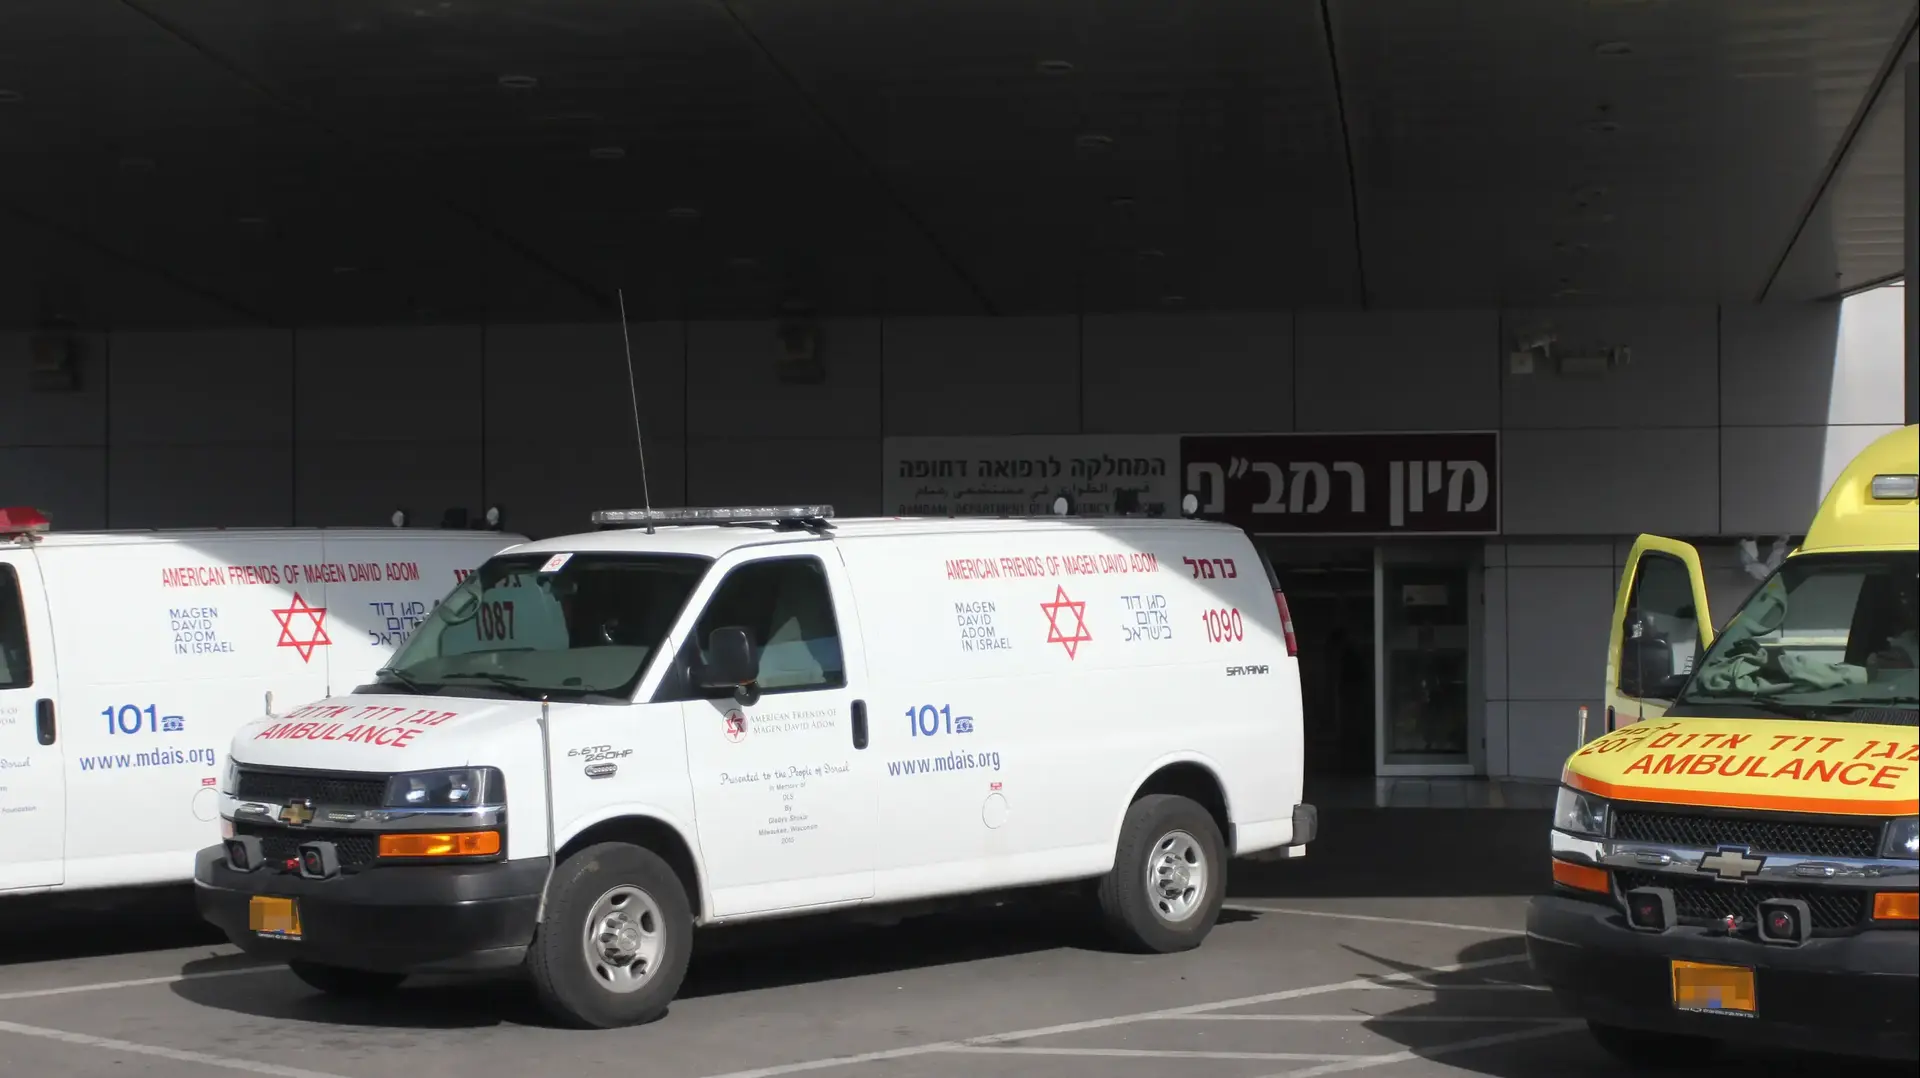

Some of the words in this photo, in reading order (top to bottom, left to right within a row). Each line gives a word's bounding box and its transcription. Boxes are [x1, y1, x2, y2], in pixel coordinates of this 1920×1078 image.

[900, 459, 967, 478] דחופה
[978, 455, 1061, 479] לרפואה
[1070, 453, 1165, 481] המחלקה
[1388, 460, 1489, 526] מיון
[162, 566, 226, 588] AMERICAN
[228, 564, 280, 585] FRIENDS
[284, 564, 300, 584] OF
[303, 563, 347, 584] MAGEN
[351, 562, 382, 582] DAVID
[386, 561, 420, 581] ADOM
[946, 558, 1000, 580] AMERICAN
[1000, 556, 1046, 578] FRIENDS
[1046, 555, 1060, 576] OF
[1062, 554, 1100, 575] MAGEN
[1100, 553, 1128, 573] DAVID
[1132, 552, 1159, 572] ADOM
[1183, 556, 1237, 579] כרמל
[369, 603, 394, 616] דוד
[955, 601, 996, 614] MAGEN
[1121, 595, 1141, 610] דוד
[169, 607, 218, 620] MAGEN
[958, 614, 992, 627] DAVID
[1136, 610, 1168, 625] אדום
[171, 619, 213, 632] DAVID
[962, 626, 996, 639] ADOM
[1121, 626, 1172, 641] בישראל
[1203, 607, 1243, 643] 1090
[174, 631, 216, 643] ADOM
[962, 639, 974, 652] IN
[976, 638, 1012, 651] ISRAEL
[175, 642, 188, 655] IN
[192, 641, 235, 654] ISRAEL
[1226, 664, 1270, 677] SAVANA
[101, 703, 157, 735] 101
[750, 711, 790, 723] AMERICAN
[792, 709, 825, 720] FRIENDS
[905, 703, 952, 737] 101
[254, 722, 425, 748] AMBULANCE
[753, 723, 782, 734] MAGEN
[784, 720, 809, 732] DAVID
[812, 719, 836, 729] ADOM
[1578, 737, 1646, 757] 207
[1647, 732, 1752, 750] אדום
[1768, 735, 1844, 754] דוד
[80, 746, 216, 771] www.mdais.org
[584, 749, 634, 762] 260HP
[887, 749, 1001, 777] www.mdais.org
[720, 772, 760, 786] Presented
[763, 771, 772, 781] to
[775, 769, 787, 780] the
[788, 765, 813, 779] People
[1623, 754, 1911, 790] AMBULANCE
